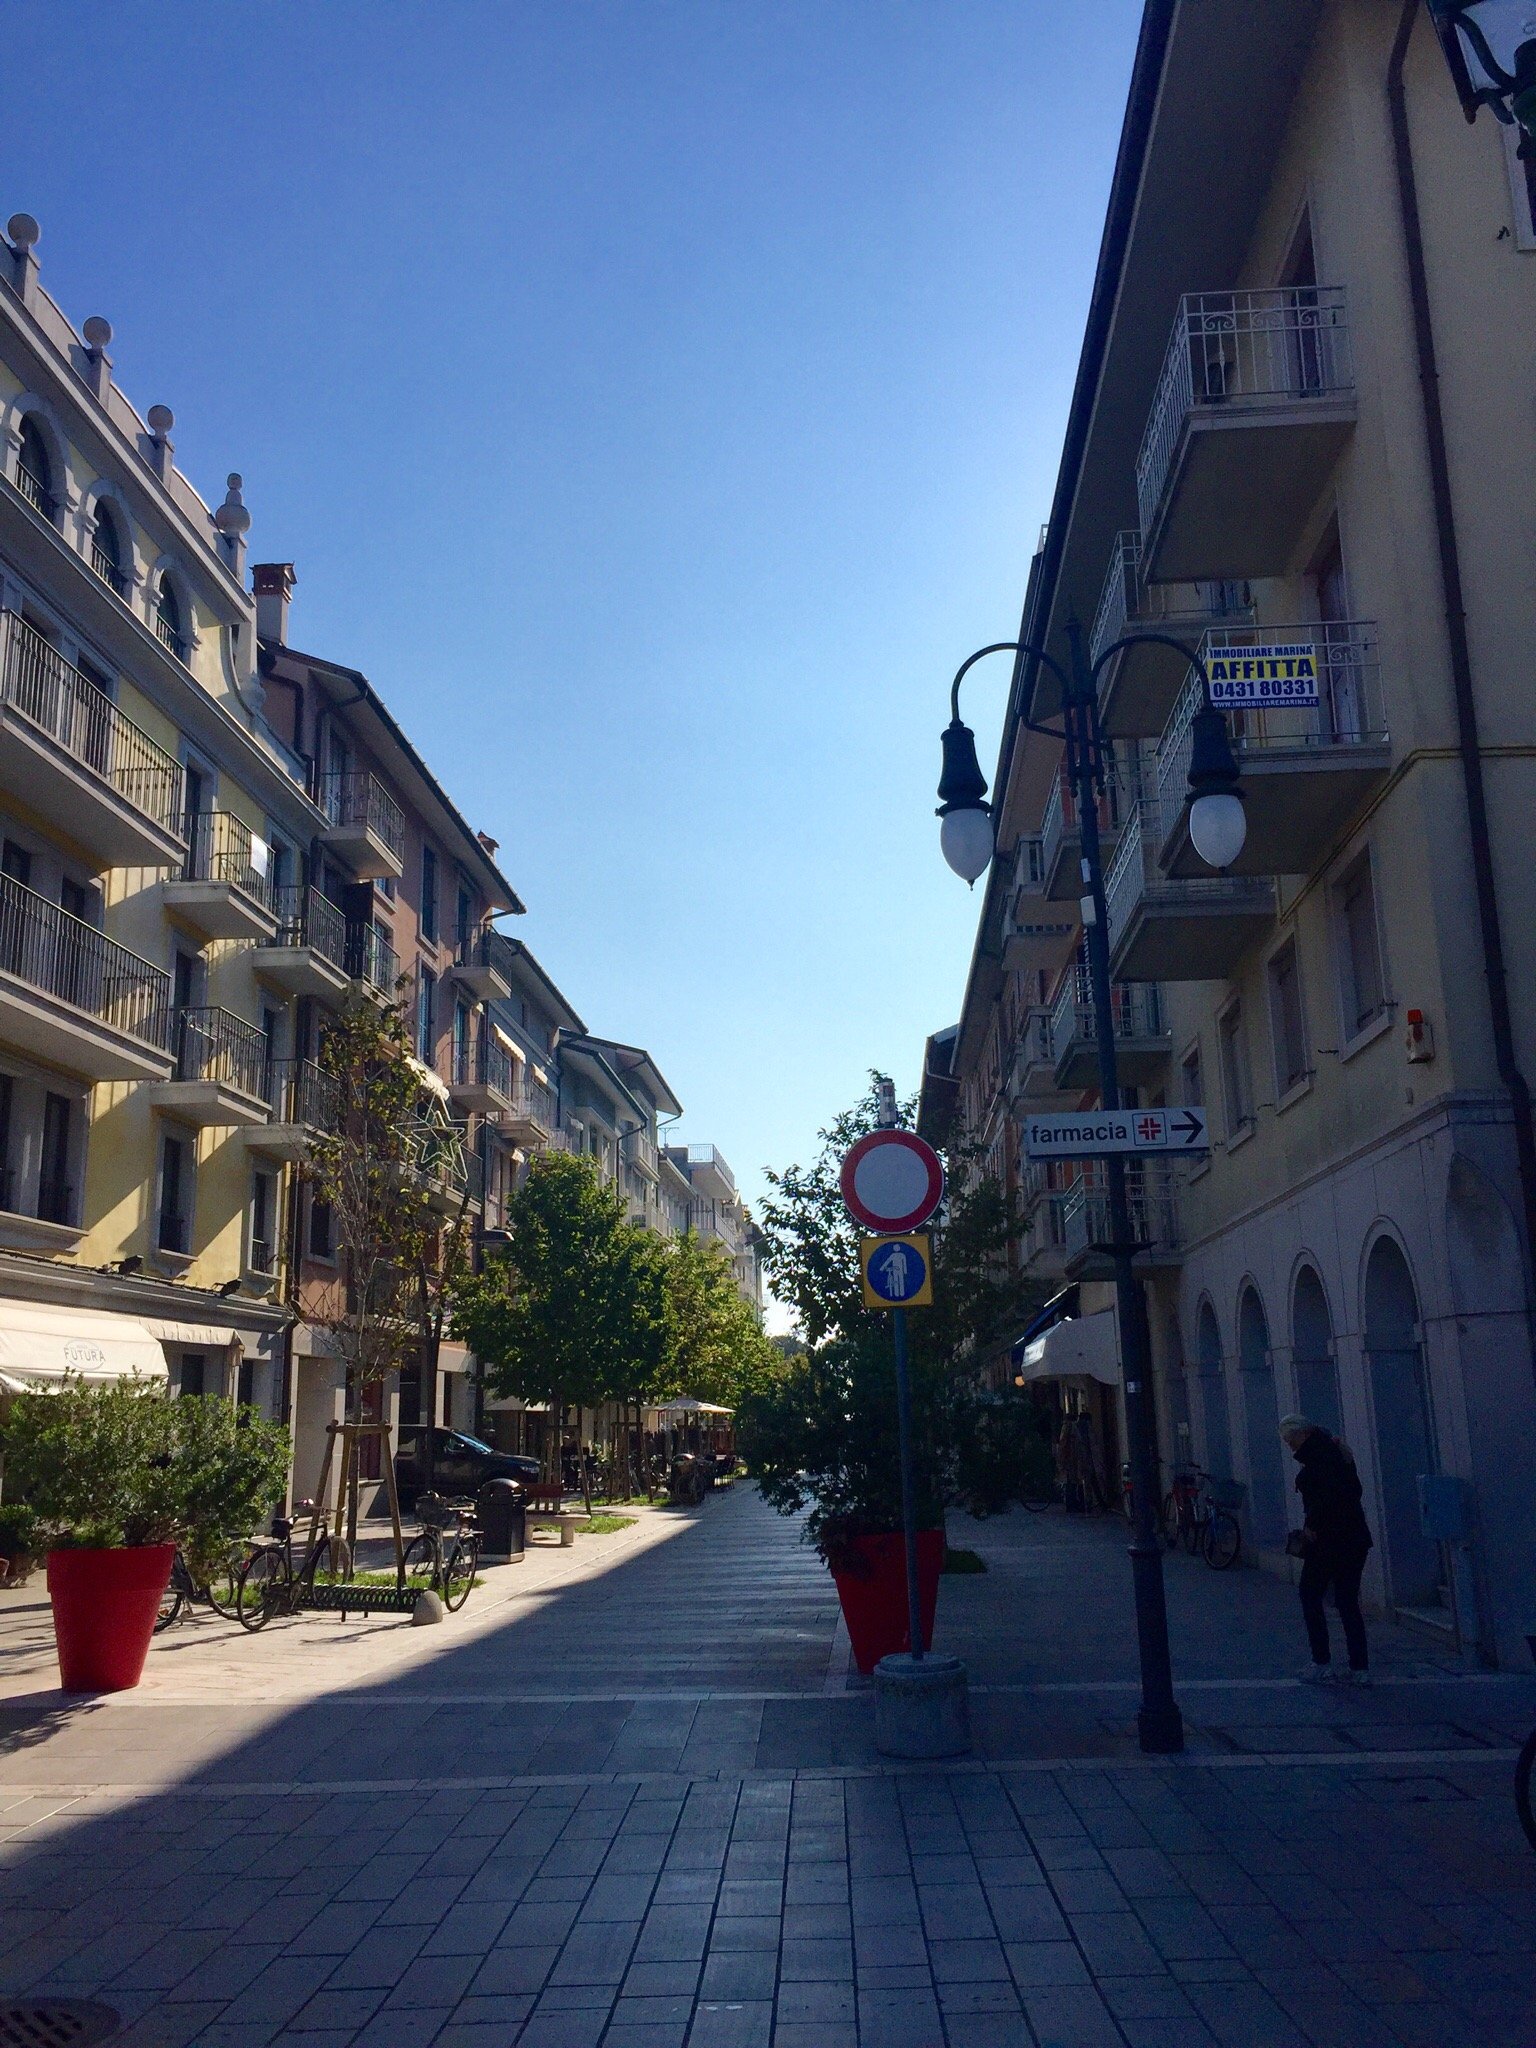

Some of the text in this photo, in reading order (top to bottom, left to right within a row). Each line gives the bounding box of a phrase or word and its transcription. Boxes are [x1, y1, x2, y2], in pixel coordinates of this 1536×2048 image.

[1210, 645, 1313, 659] IMMOBILIARE MARINA
[1211, 659, 1314, 680] AFFITTA
[1213, 679, 1314, 697] 0431 80331
[1031, 1121, 1128, 1144] farmacia
[63, 1347, 106, 1362] FUTURA
